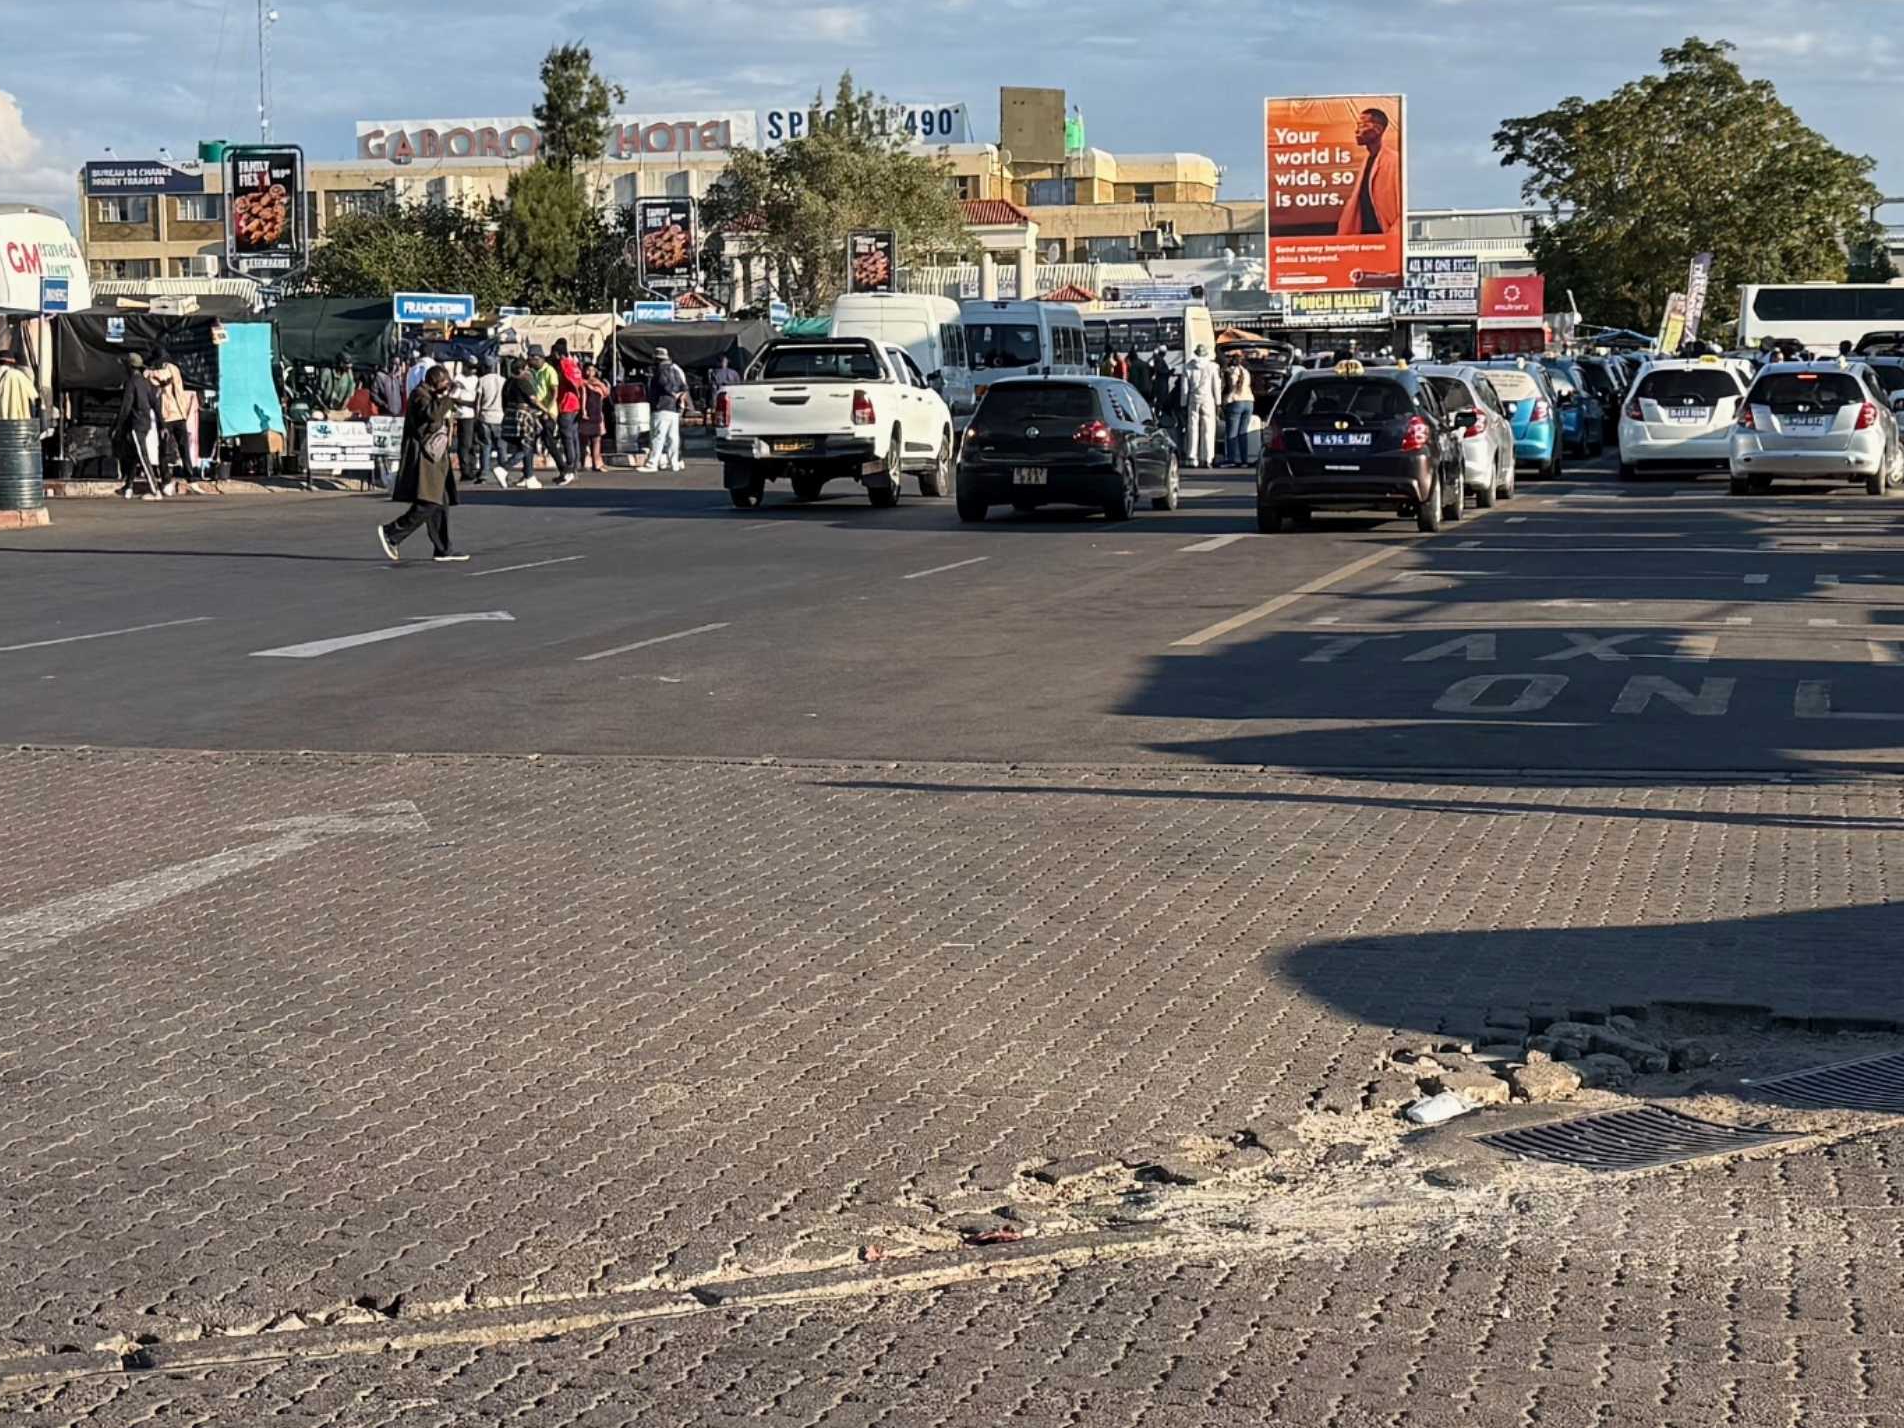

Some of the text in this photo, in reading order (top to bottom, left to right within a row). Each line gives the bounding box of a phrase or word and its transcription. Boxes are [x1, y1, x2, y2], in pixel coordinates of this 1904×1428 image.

[366, 119, 733, 159] GABORO HOTEL
[1275, 128, 1320, 144] Your
[1275, 147, 1351, 165] world is
[1275, 169, 1354, 187] wide, so
[1275, 191, 1345, 207] is ours.
[7, 241, 43, 275] GM
